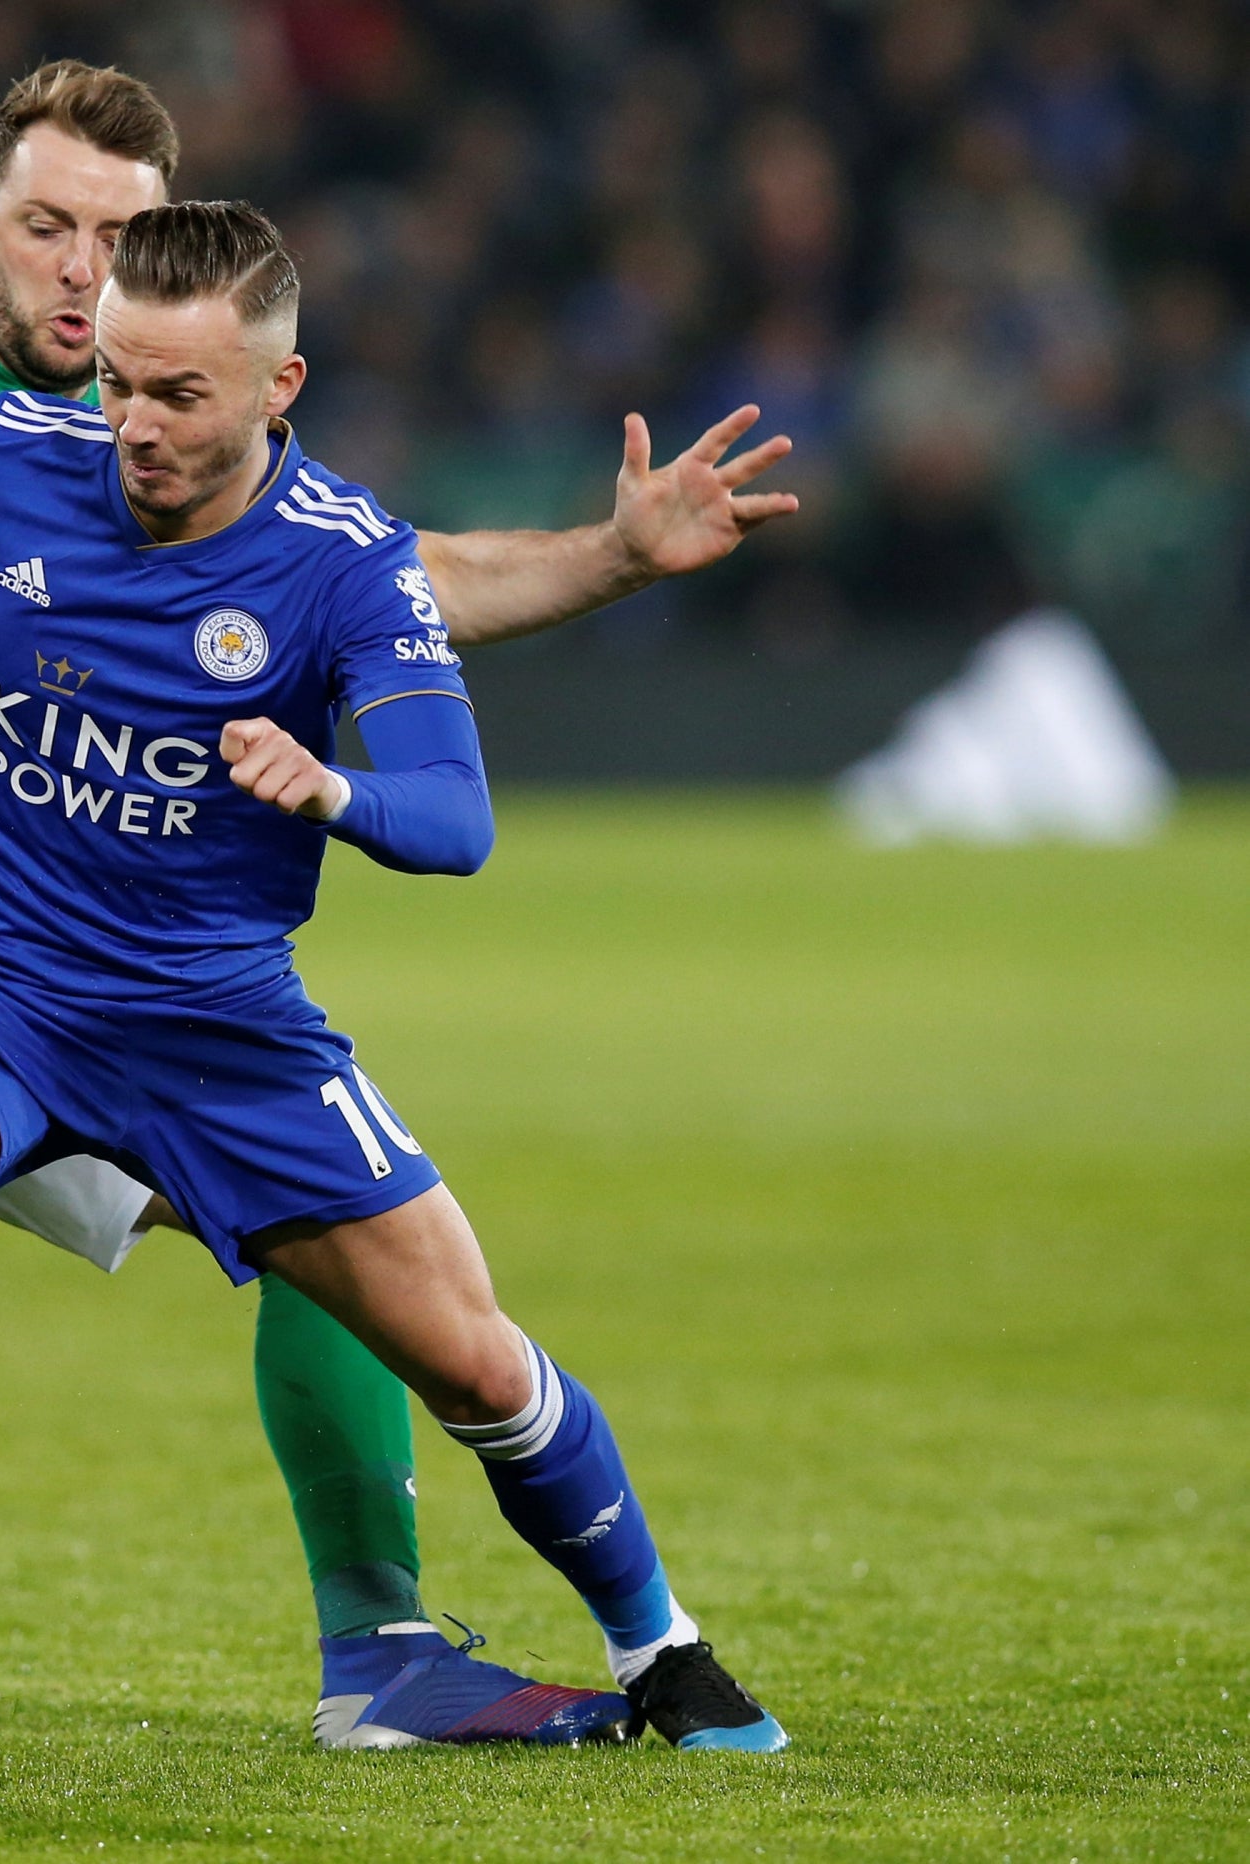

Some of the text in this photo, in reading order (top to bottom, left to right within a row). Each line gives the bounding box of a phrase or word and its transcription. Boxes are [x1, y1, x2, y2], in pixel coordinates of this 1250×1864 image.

[203, 614, 262, 650] LEICESTER CITY
[201, 640, 260, 675] FOOTBALL CLUB
